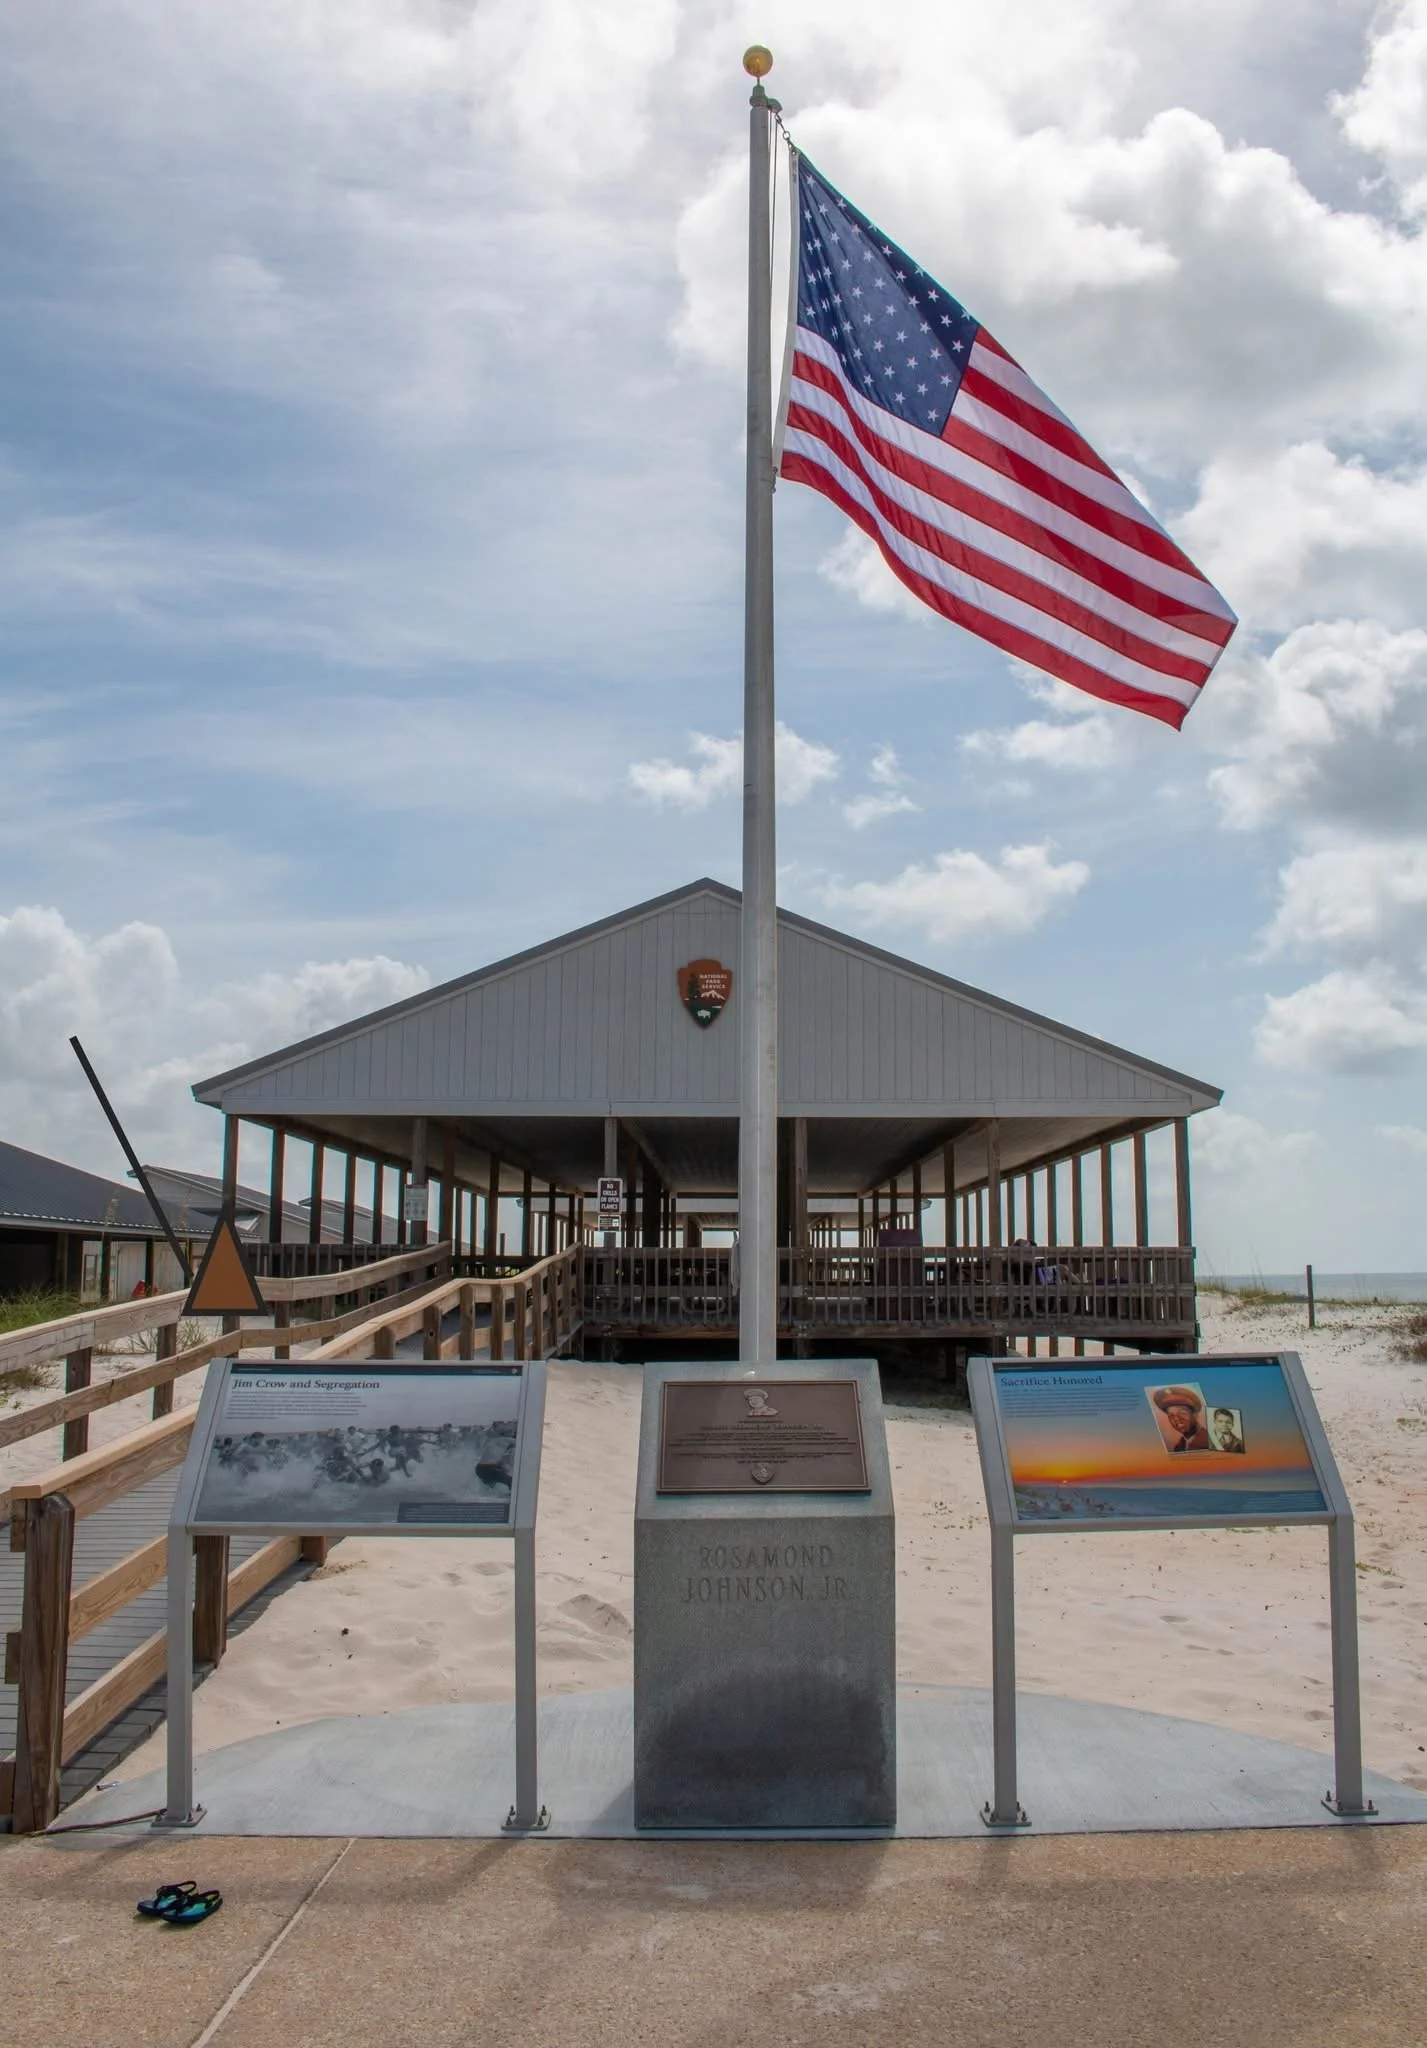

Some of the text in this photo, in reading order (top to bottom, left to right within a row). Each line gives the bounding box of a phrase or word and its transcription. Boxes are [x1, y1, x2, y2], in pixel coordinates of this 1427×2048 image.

[232, 1379, 380, 1390] Jim Crow and Segregation
[1000, 1375, 1105, 1387] Sacrifice Honored
[701, 1545, 833, 1569] ROSAMOND
